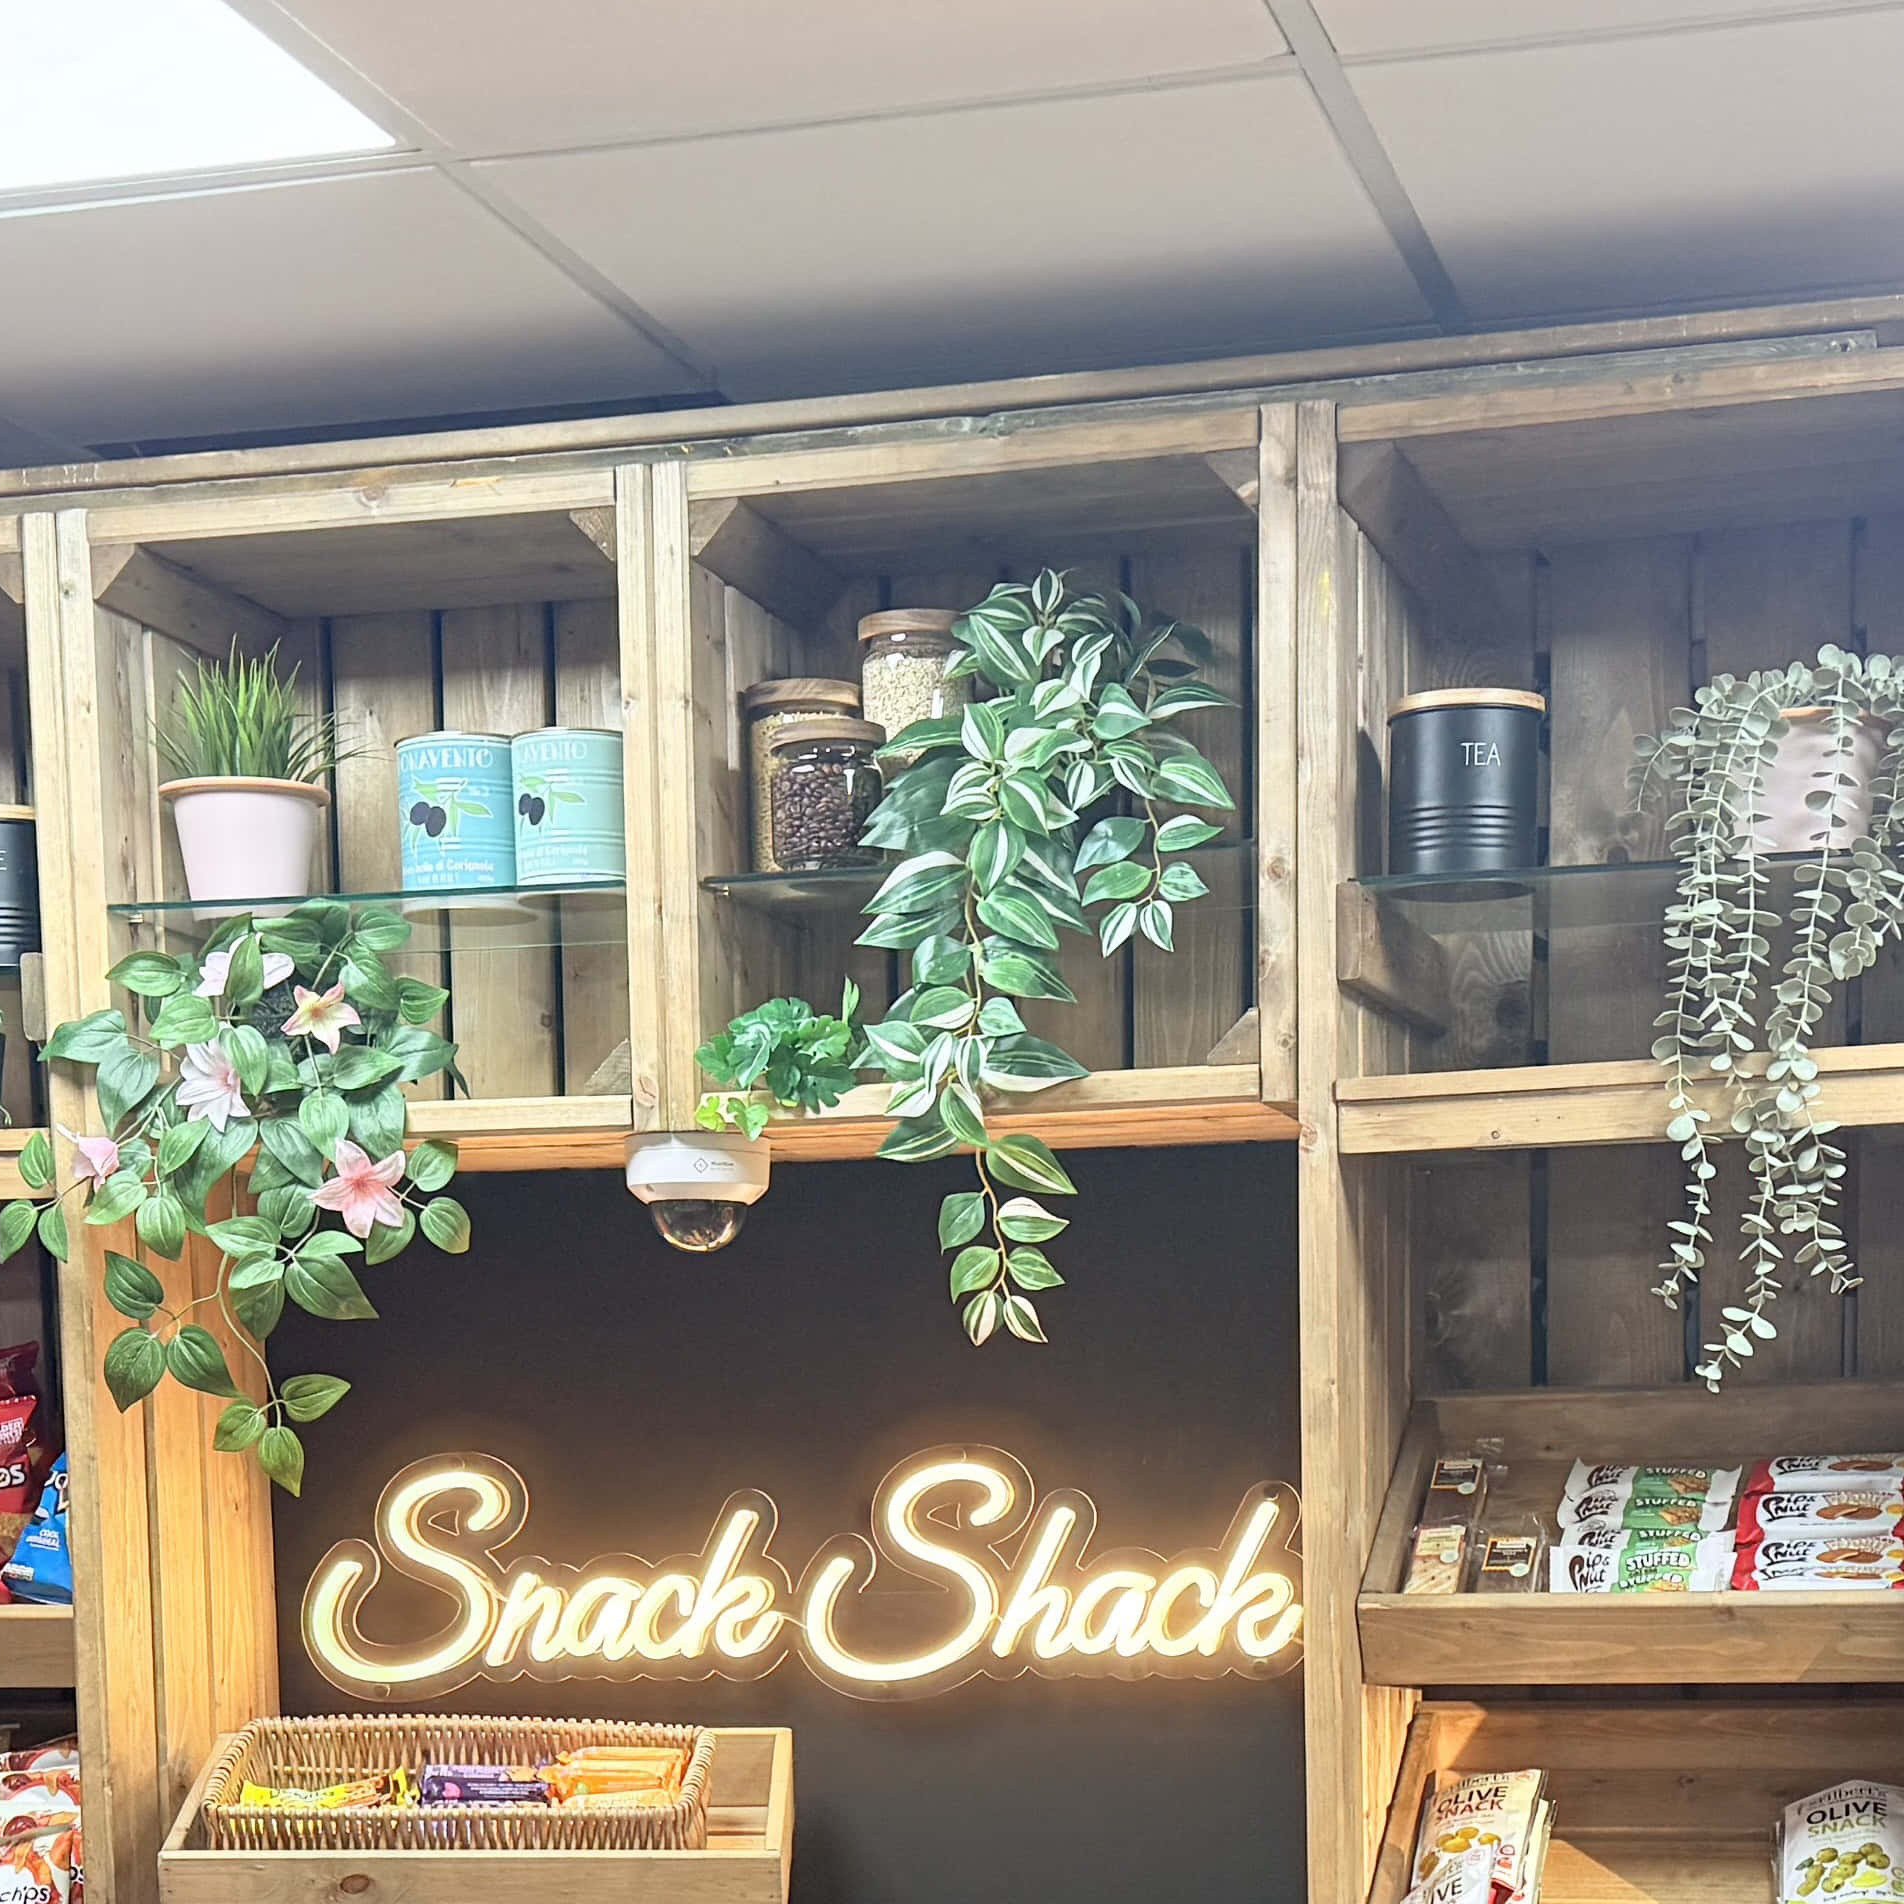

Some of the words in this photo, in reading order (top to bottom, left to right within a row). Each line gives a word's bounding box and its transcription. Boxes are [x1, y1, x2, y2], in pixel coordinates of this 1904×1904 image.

[1460, 742, 1501, 766] TEA
[312, 1470, 784, 1684] Snack
[808, 1460, 1304, 1682] Shack
[1626, 1552, 1691, 1571] STUFFED
[1438, 1785, 1509, 1814] OLIVE
[1806, 1801, 1889, 1825] OLIVE
[1808, 1813, 1886, 1837] SNACK
